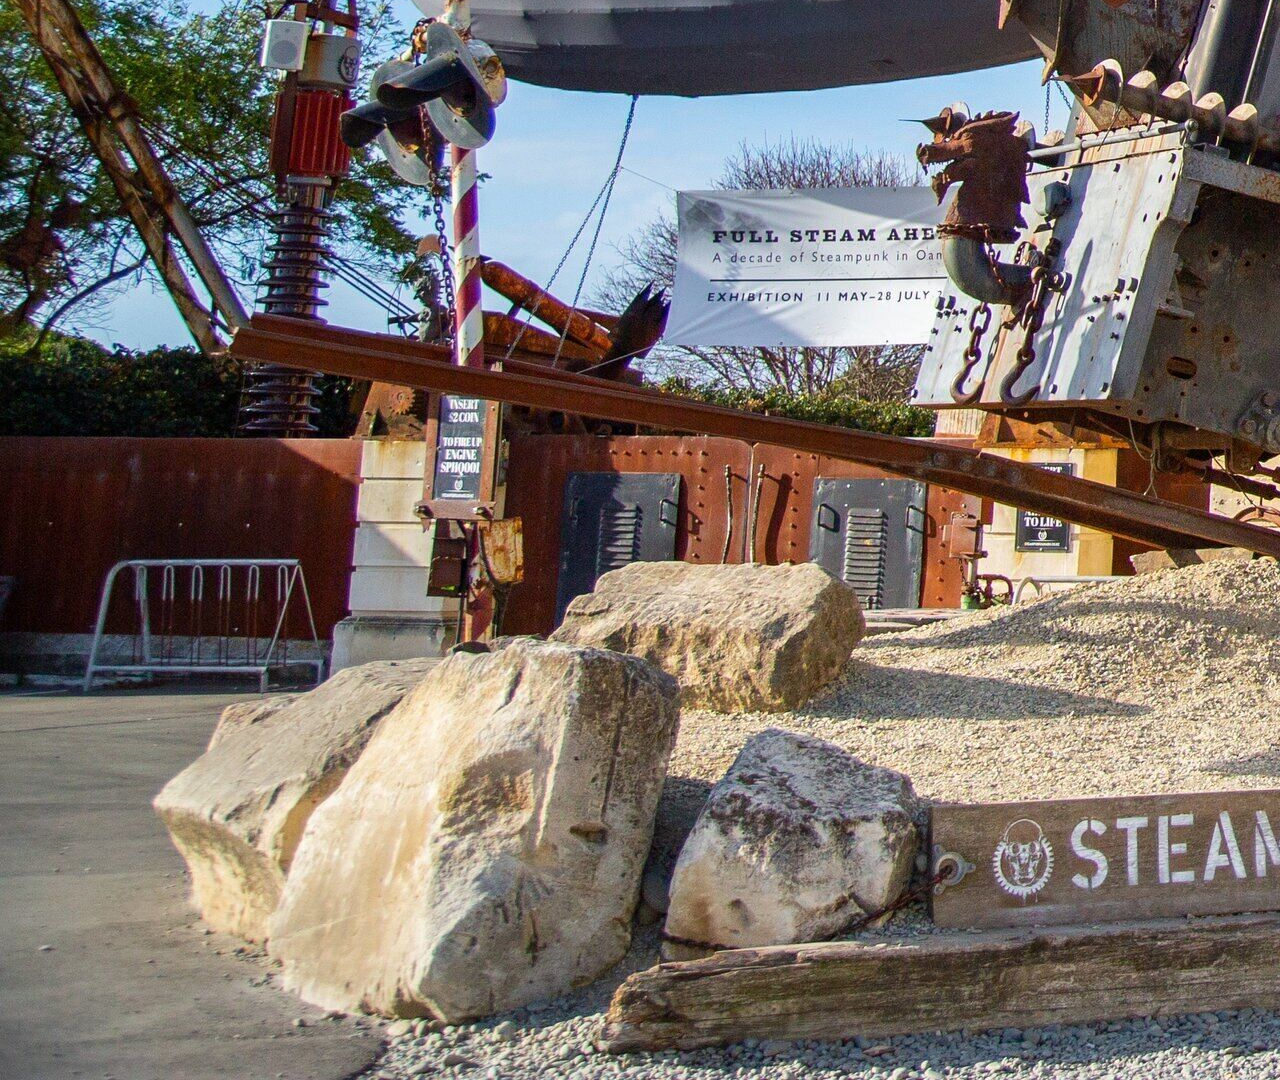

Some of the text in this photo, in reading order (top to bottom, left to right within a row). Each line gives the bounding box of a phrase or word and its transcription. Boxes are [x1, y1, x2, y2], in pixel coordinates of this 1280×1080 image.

[712, 227, 944, 243] FULL STEAM AHE
[711, 252, 722, 263] A
[730, 251, 782, 263] decade
[790, 251, 804, 263] of
[811, 249, 889, 264] Steampunk
[896, 250, 908, 261] in
[707, 292, 803, 302] EXHIBITION
[816, 292, 830, 302] 11
[897, 290, 930, 303] JULY
[449, 399, 480, 410] INSERT
[459, 411, 480, 423] COIN
[443, 436, 483, 447] TO FIRE UP
[445, 448, 477, 460] ENGINE
[1023, 516, 1063, 528] TO LIFE
